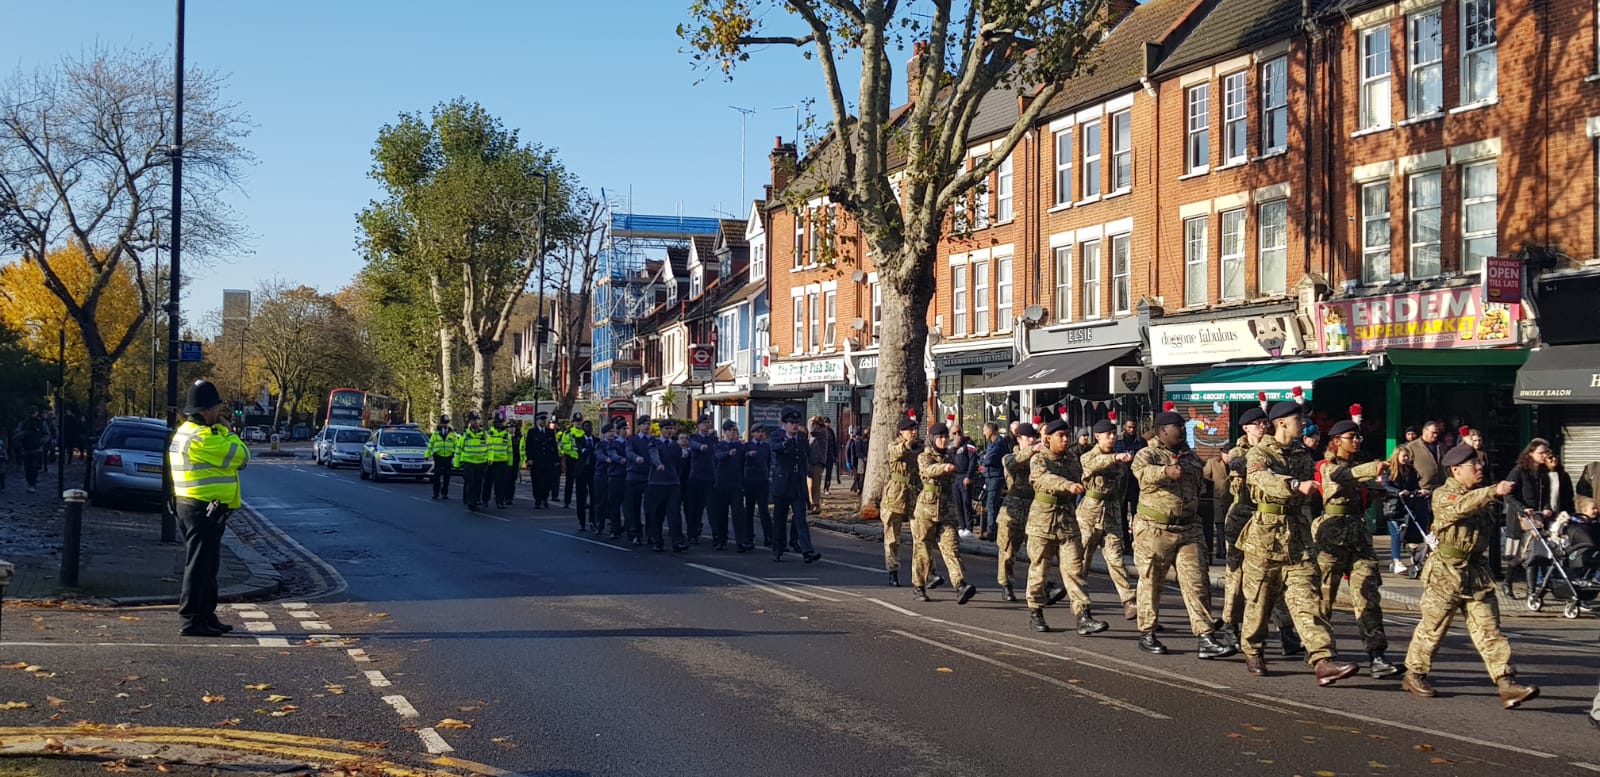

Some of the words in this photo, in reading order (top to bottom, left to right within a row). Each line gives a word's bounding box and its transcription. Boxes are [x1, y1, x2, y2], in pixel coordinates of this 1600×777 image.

[1488, 267, 1520, 279] OPEN
[1489, 279, 1502, 287] TILL
[1503, 280, 1519, 288] LATE
[1351, 291, 1477, 326] ERDEM
[1068, 328, 1092, 343] ELSIE
[1354, 316, 1476, 341] SUPERMARKET
[1161, 331, 1197, 348] doggone
[1199, 328, 1238, 343] fabulous
[809, 361, 823, 374] Fish
[824, 360, 836, 372] Bar
[1519, 389, 1545, 397] UNISEX
